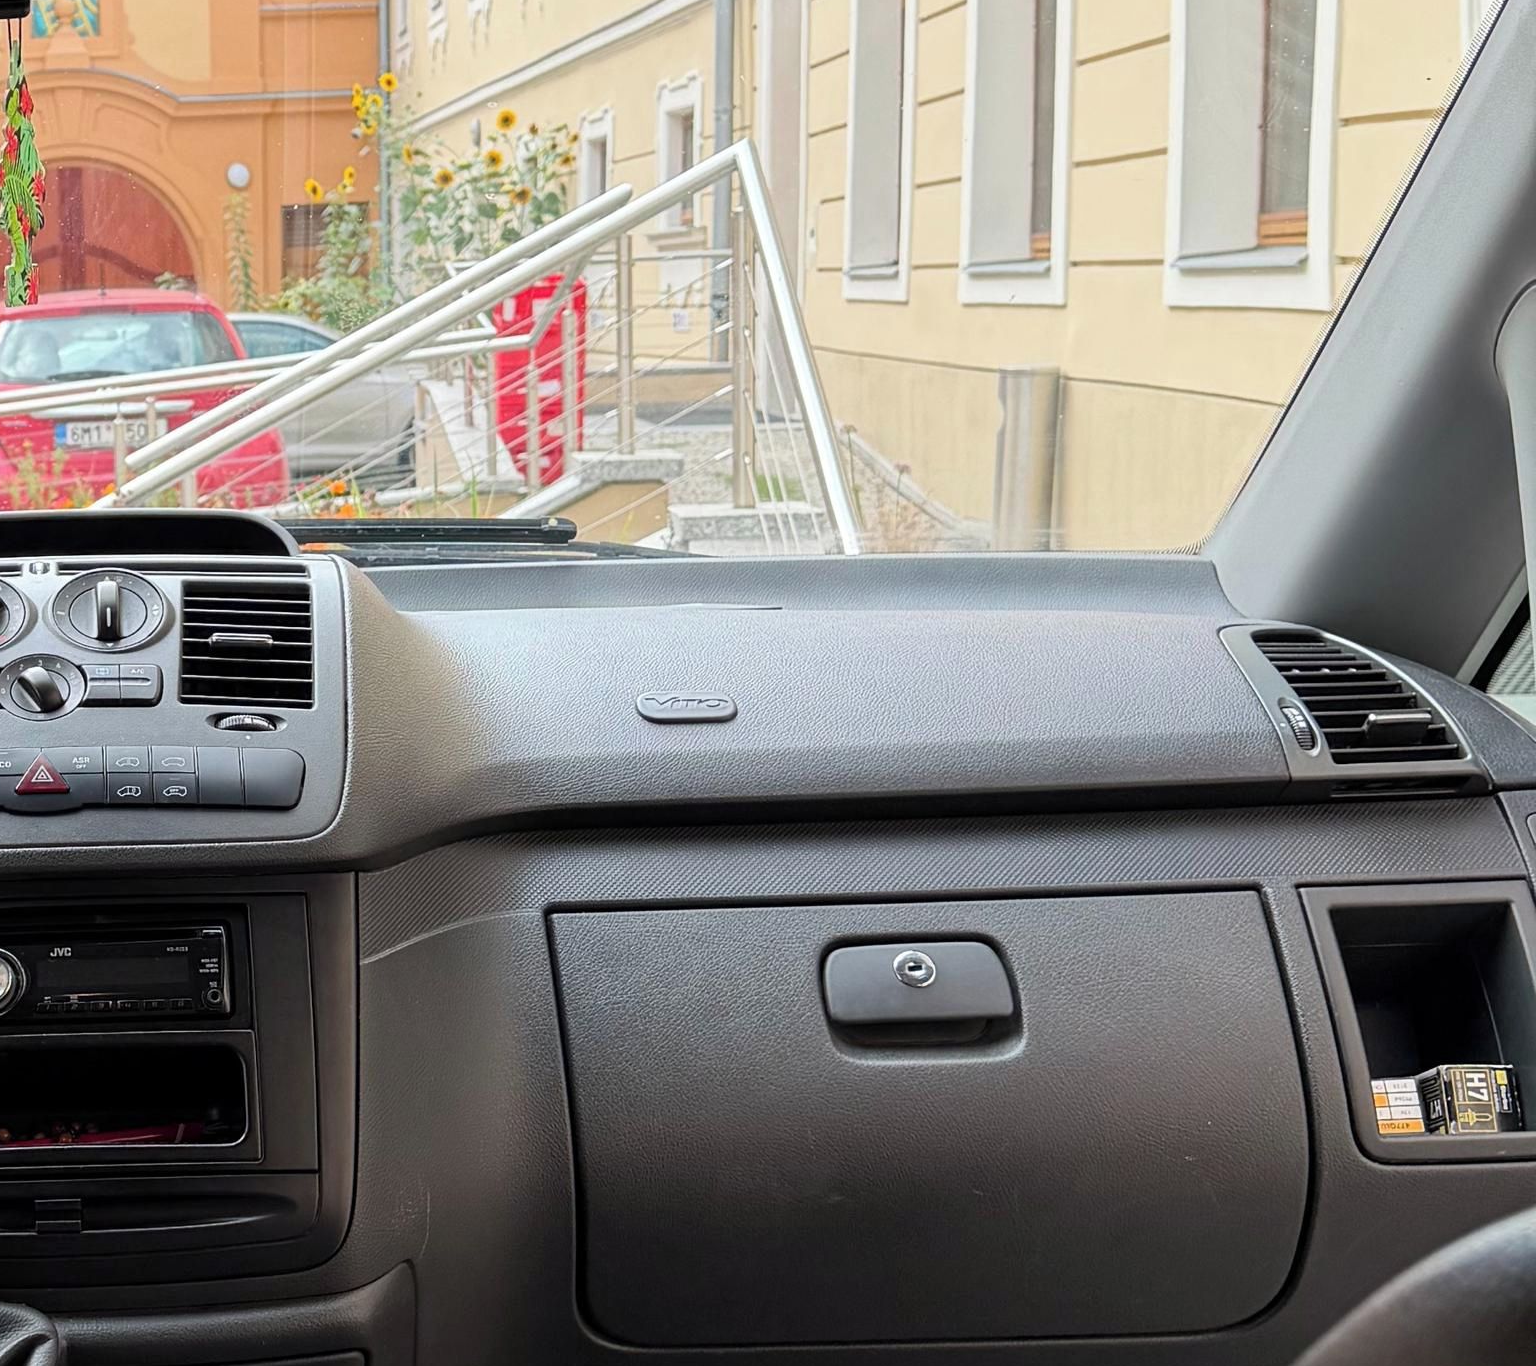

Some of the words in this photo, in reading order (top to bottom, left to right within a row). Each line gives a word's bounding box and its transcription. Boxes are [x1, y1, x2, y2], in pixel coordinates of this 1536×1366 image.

[72, 756, 90, 765] ASR
[50, 947, 72, 957] JVC
[1465, 1072, 1490, 1102] H7
